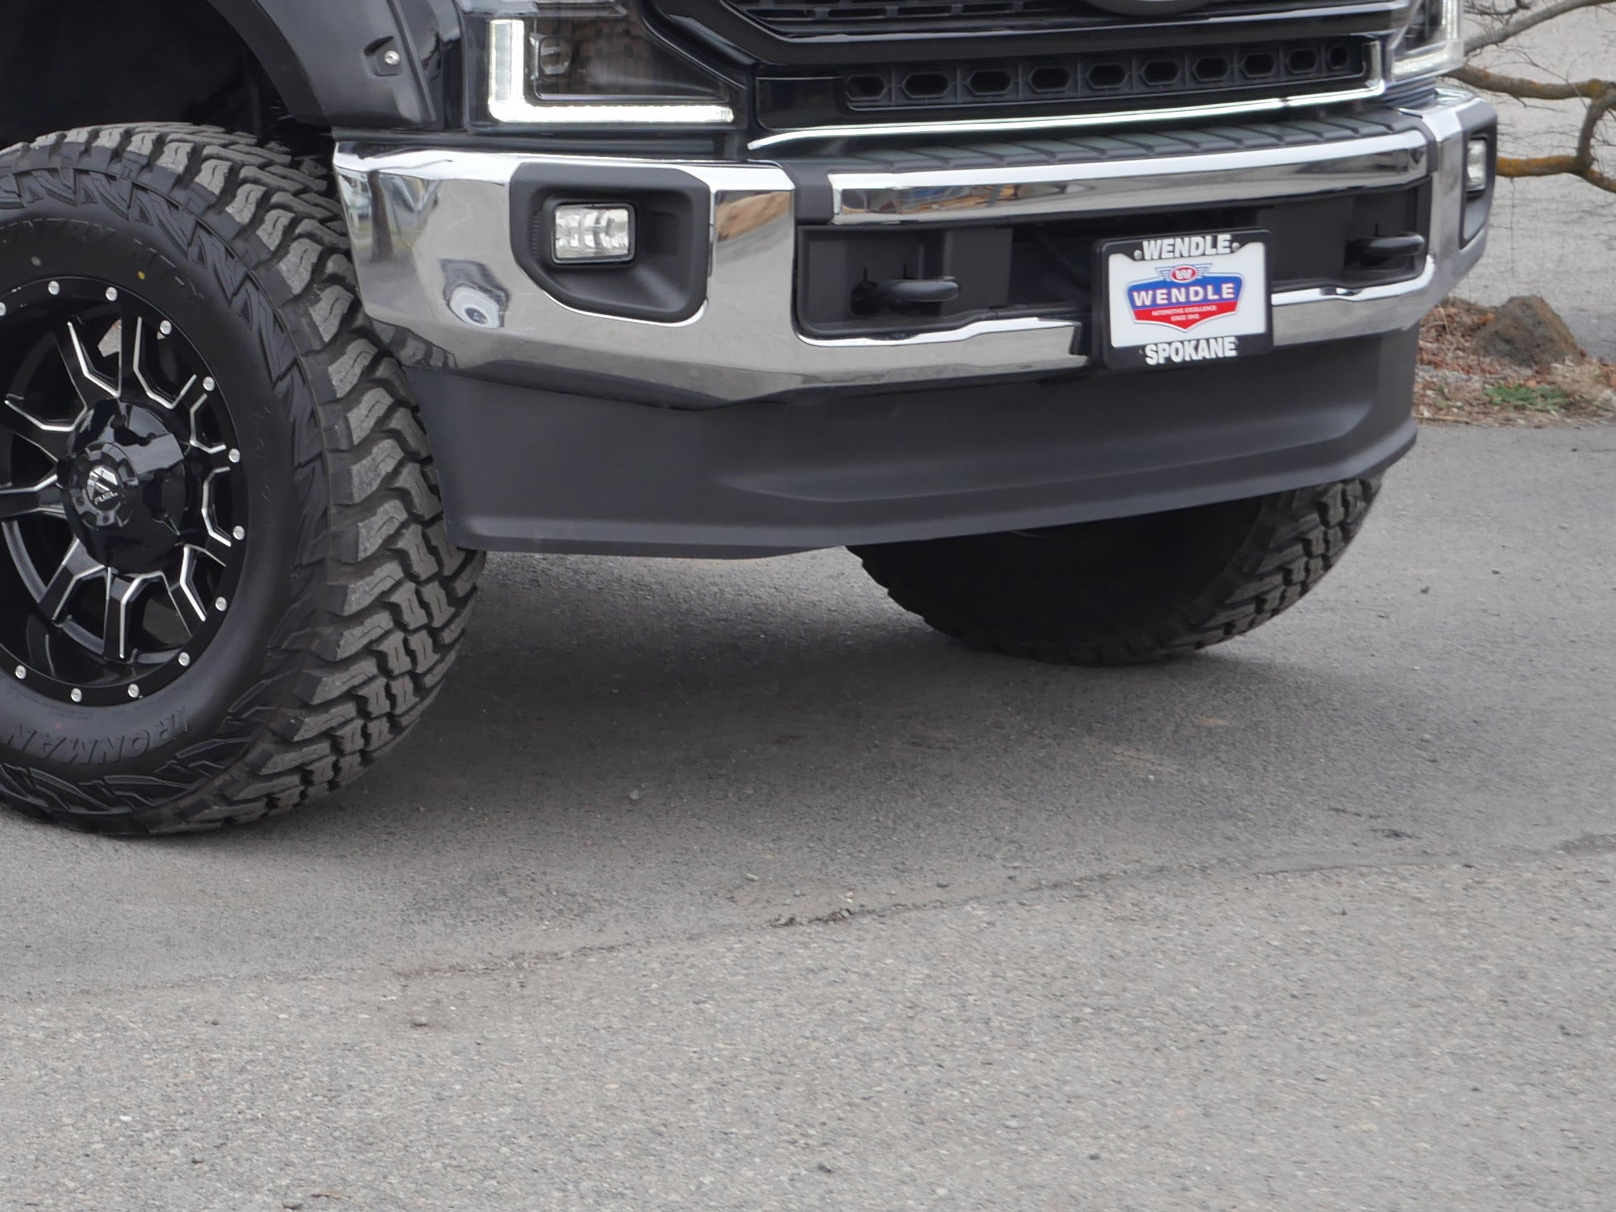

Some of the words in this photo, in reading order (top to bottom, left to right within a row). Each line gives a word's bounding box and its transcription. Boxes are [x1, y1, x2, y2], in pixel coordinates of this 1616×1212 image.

[1142, 233, 1232, 261] WENDLE
[1132, 282, 1236, 307] WENDLE
[1145, 336, 1237, 366] SPOKANE
[3, 705, 190, 766] IRONMAN
